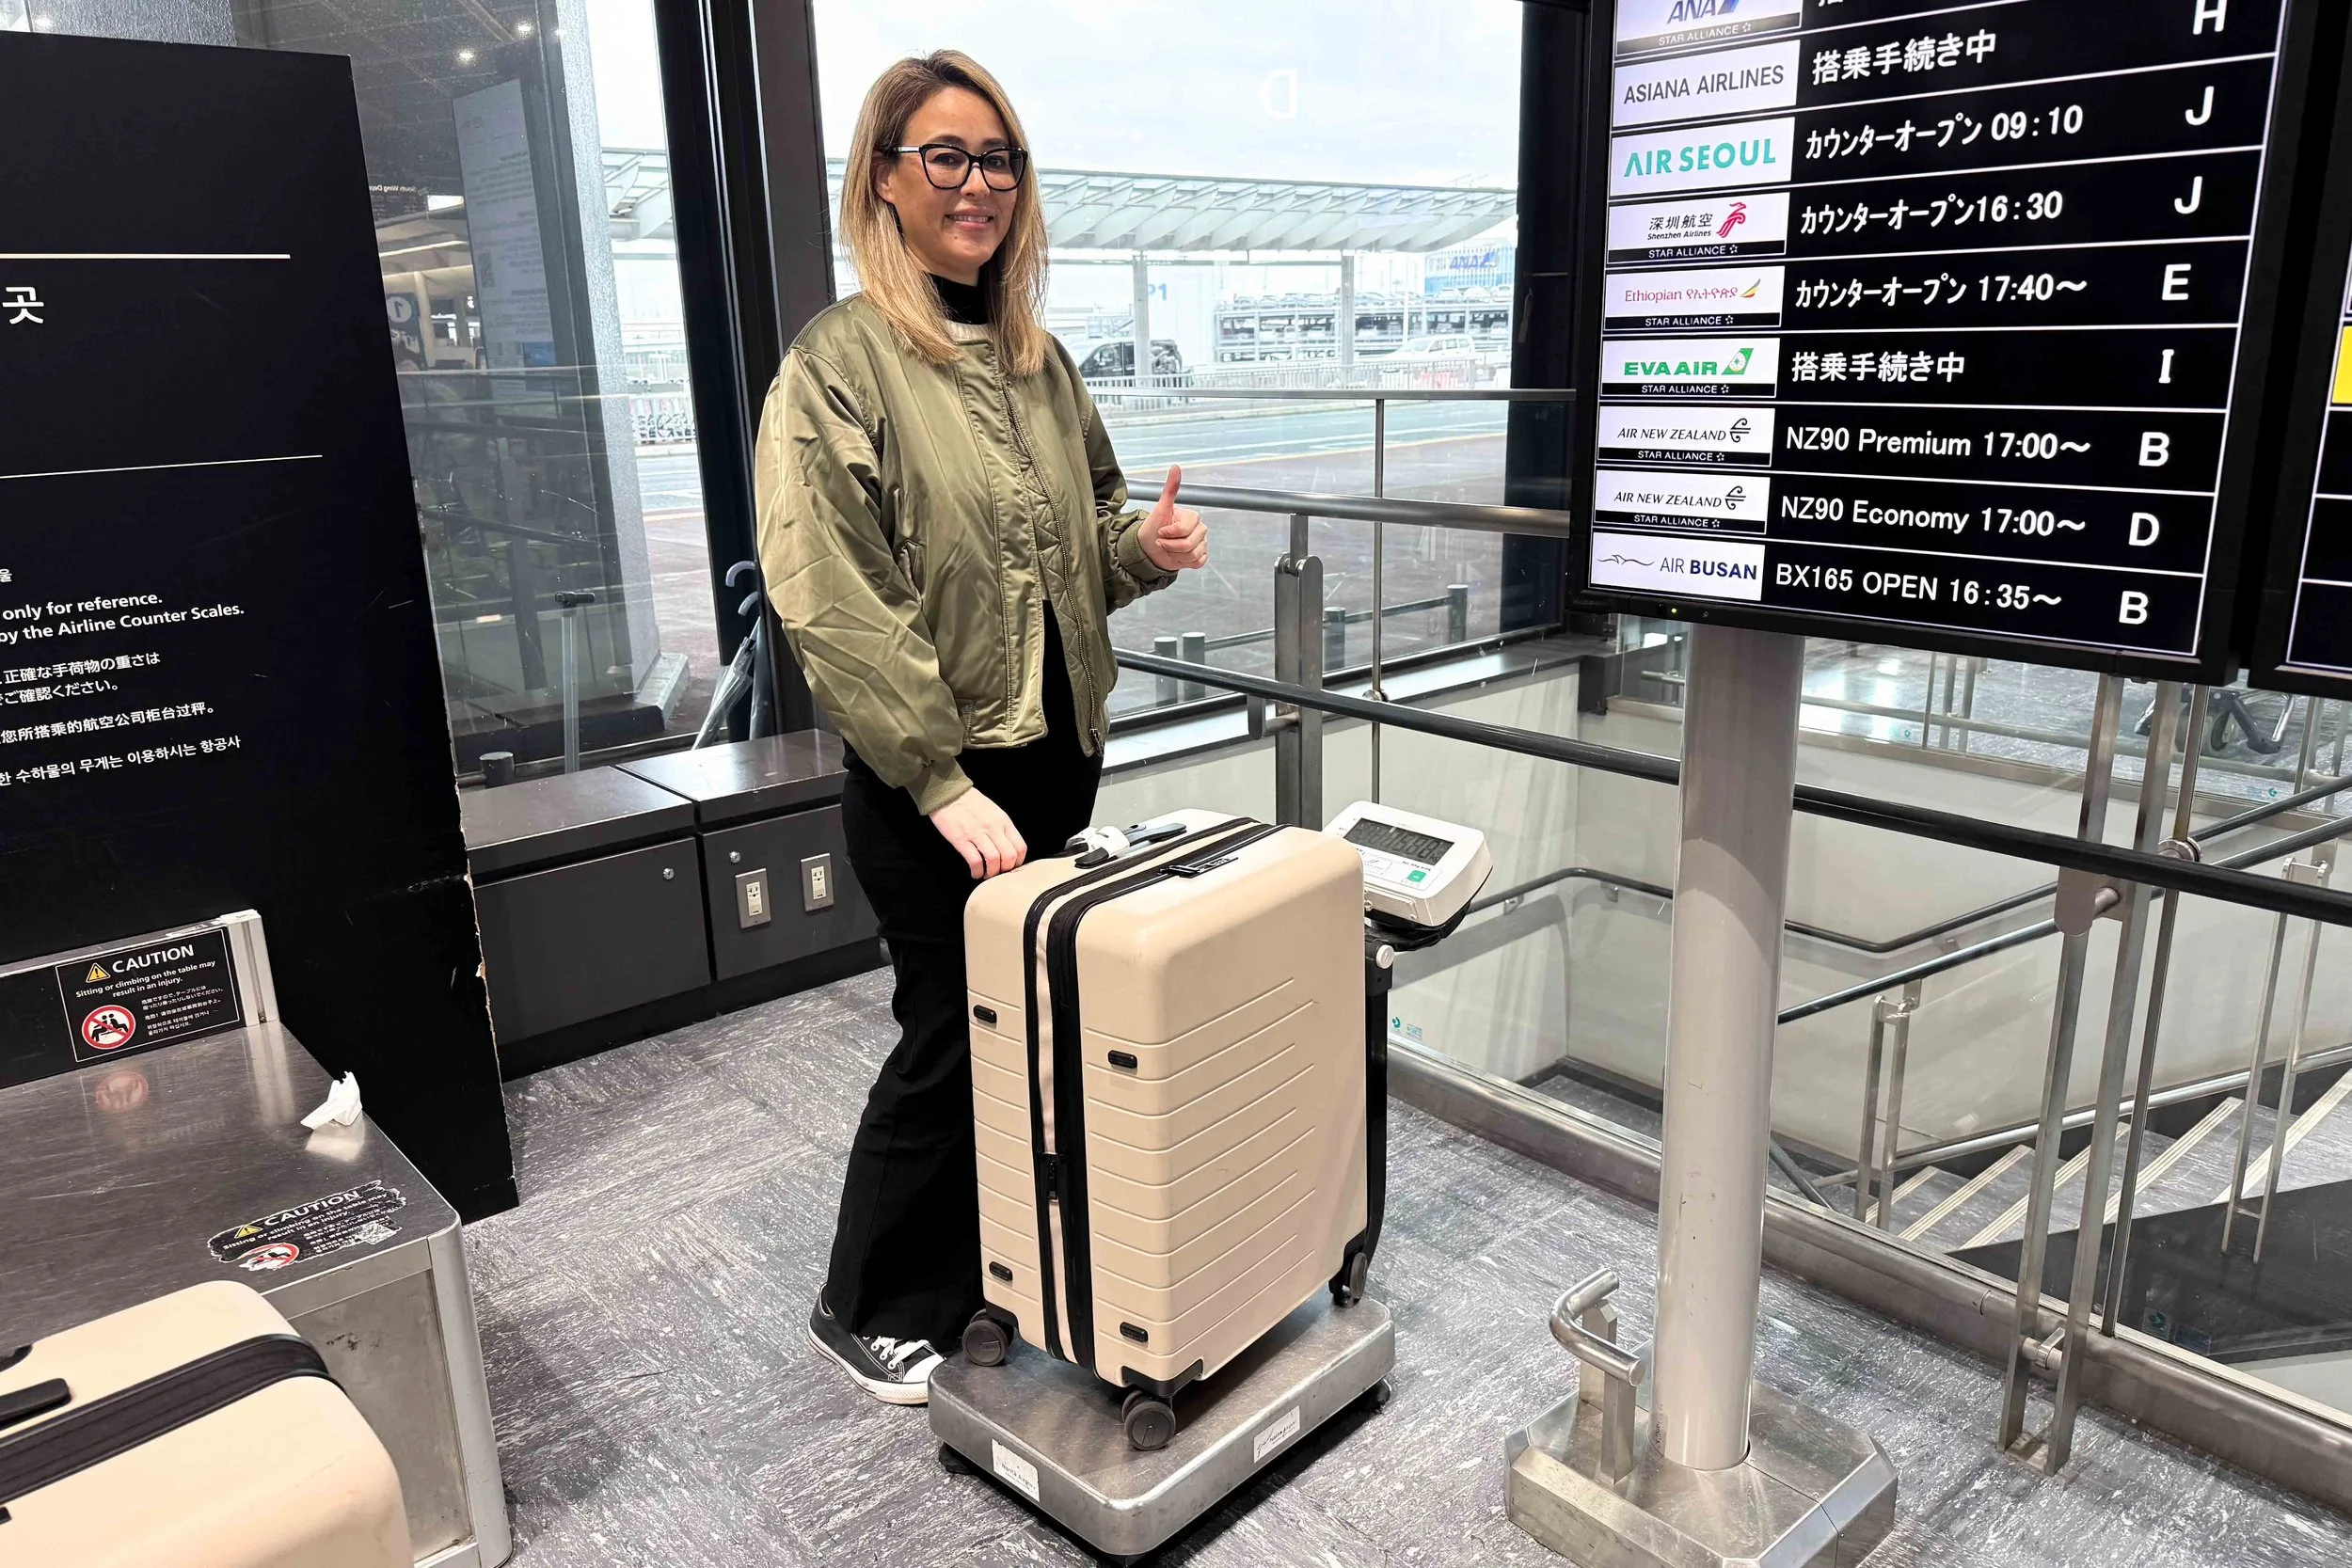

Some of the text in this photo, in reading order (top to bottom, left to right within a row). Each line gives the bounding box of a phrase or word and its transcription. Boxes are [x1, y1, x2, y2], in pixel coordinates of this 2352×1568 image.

[1667, 0, 1718, 24] ANA
[2192, 0, 2228, 35] H
[1659, 24, 1739, 46] STAR ALLIANCE
[1812, 29, 1996, 86] 搭乗手続き中
[1624, 65, 1784, 104] ASIANA AIRLINES
[2185, 86, 2215, 126] J
[1624, 138, 1776, 177] AIR SEOUL
[2174, 176, 2201, 215] J
[1649, 213, 1713, 230] 深圳航空
[1683, 230, 1711, 238] Airlines
[1648, 245, 1725, 258] STAR ALLIANCE
[1625, 289, 1682, 303] Ethiopian
[2161, 264, 2190, 301] E
[2, 286, 44, 325] 곳
[1645, 316, 1722, 326] STAR ALLIANCE
[1624, 361, 1718, 375] EVA AIR
[1791, 352, 1965, 384] 搭乗手続き中
[2158, 349, 2174, 384] I
[1668, 386, 1718, 394] ALLIANCE
[1617, 428, 1726, 441] AIR NEW ZEALAND
[1786, 427, 1851, 453] NZ90
[1857, 428, 1971, 457] Premium
[2137, 432, 2170, 467] B
[1638, 451, 1713, 461] STAR ALLIANCE
[1613, 491, 1722, 508] AIR NEW ZEALAND
[1781, 496, 1844, 524] NZ90
[1851, 500, 1969, 536] Economy
[1634, 515, 1708, 528] STAR ALLIANCE
[2128, 512, 2161, 547] D
[1660, 557, 1757, 580] AIR BUSAN
[1774, 563, 1852, 594] BX165
[1861, 569, 1938, 604] OPEN
[2, 594, 163, 621] only for reference.
[23, 625, 54, 640] the
[58, 618, 116, 636] Airline
[119, 610, 187, 628] Counter
[191, 604, 245, 621] Scales.
[2118, 591, 2149, 626] B
[0, 702, 214, 744] 您所搭乘的航空公司柜台过秤。
[16, 761, 76, 783] 수하물의
[79, 755, 123, 772] 무게는
[127, 743, 197, 765] 이용하시는
[199, 735, 241, 753] 항공사
[112, 944, 195, 974] CAUTION
[75, 988, 103, 998] Sitting
[115, 974, 151, 990] climbing
[163, 969, 177, 978] the
[178, 965, 198, 975] table
[199, 960, 216, 971] may
[112, 988, 136, 998] result
[158, 977, 183, 989] injury.
[223, 1238, 256, 1250] Sitting
[270, 1219, 313, 1236] climbing
[326, 1208, 342, 1216] the
[342, 1200, 366, 1212] table
[368, 1193, 388, 1205] may
[264, 1191, 360, 1226] CAUTION
[267, 1229, 294, 1240] result
